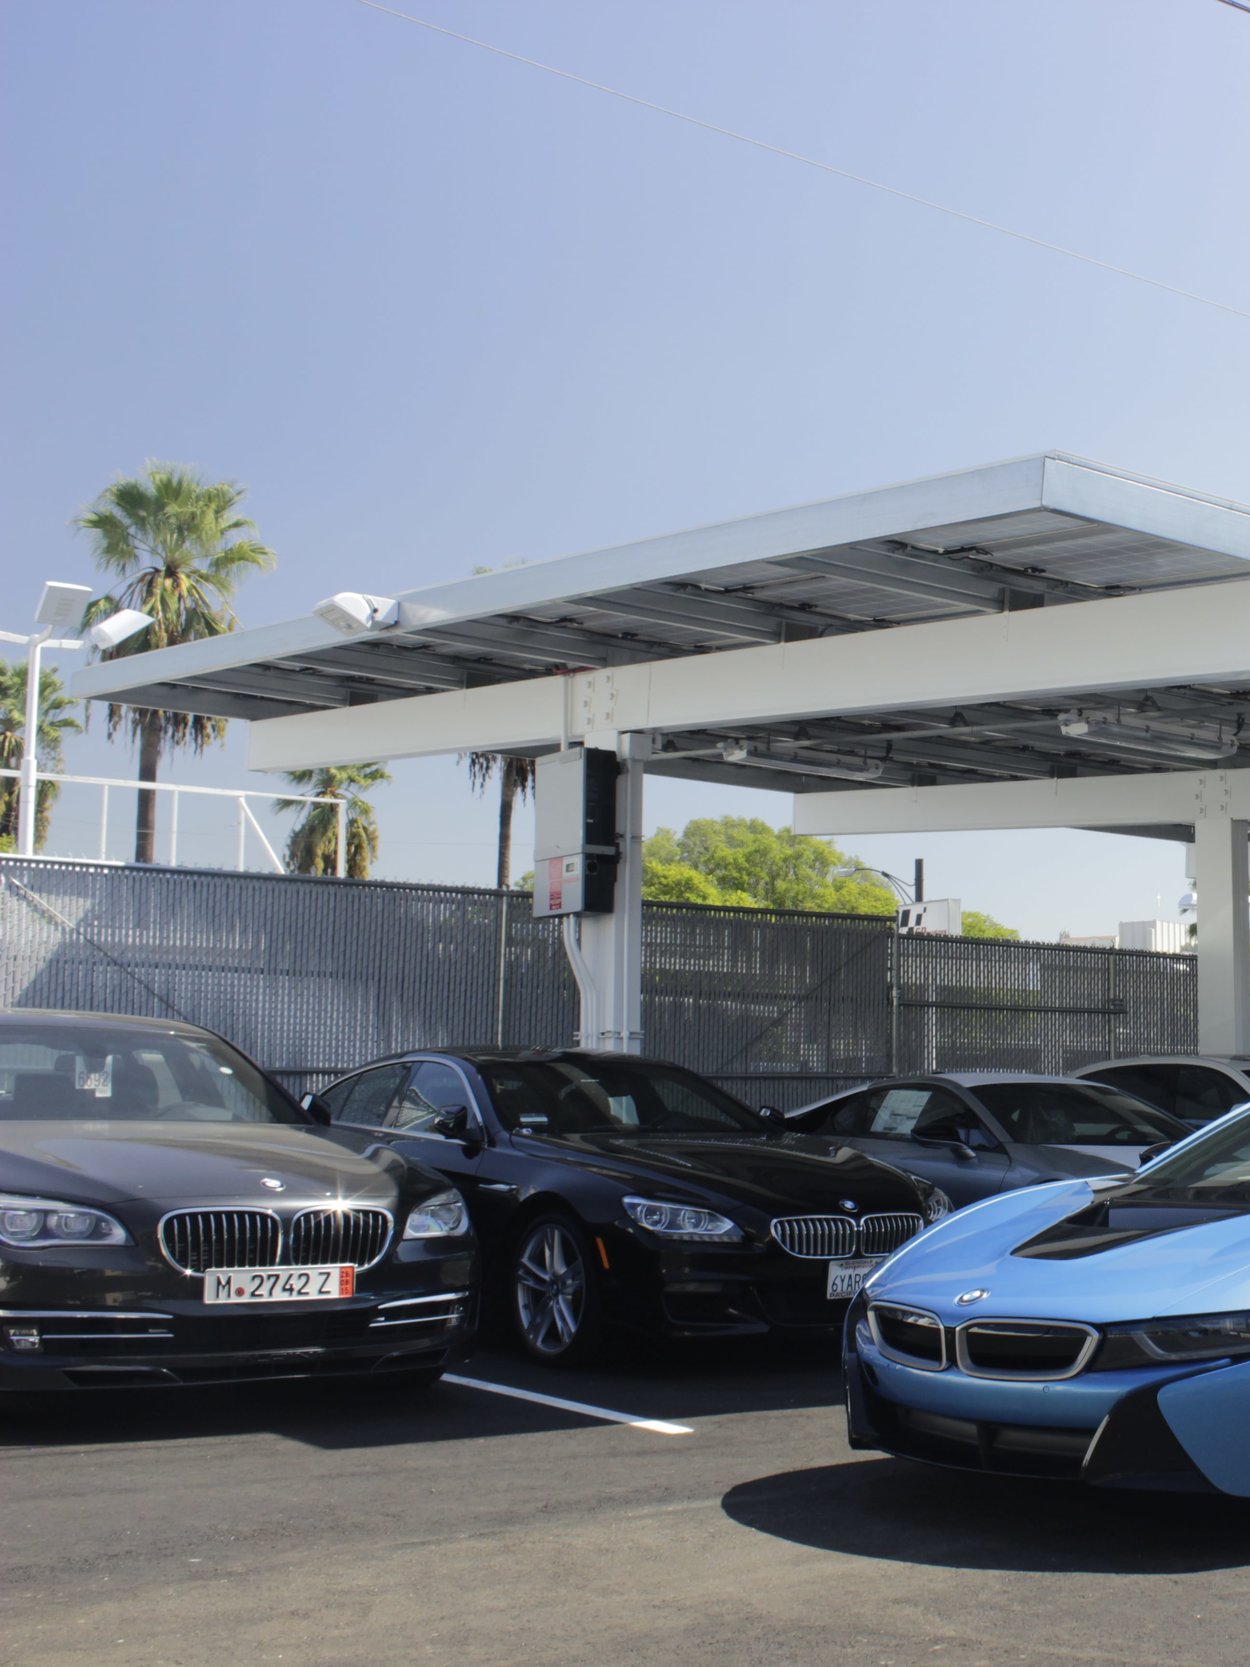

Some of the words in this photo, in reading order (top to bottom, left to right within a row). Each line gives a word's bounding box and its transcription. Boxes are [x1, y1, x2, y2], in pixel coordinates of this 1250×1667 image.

[216, 1274, 232, 1298] M
[251, 1272, 311, 1297] 2742
[318, 1271, 332, 1294] Z
